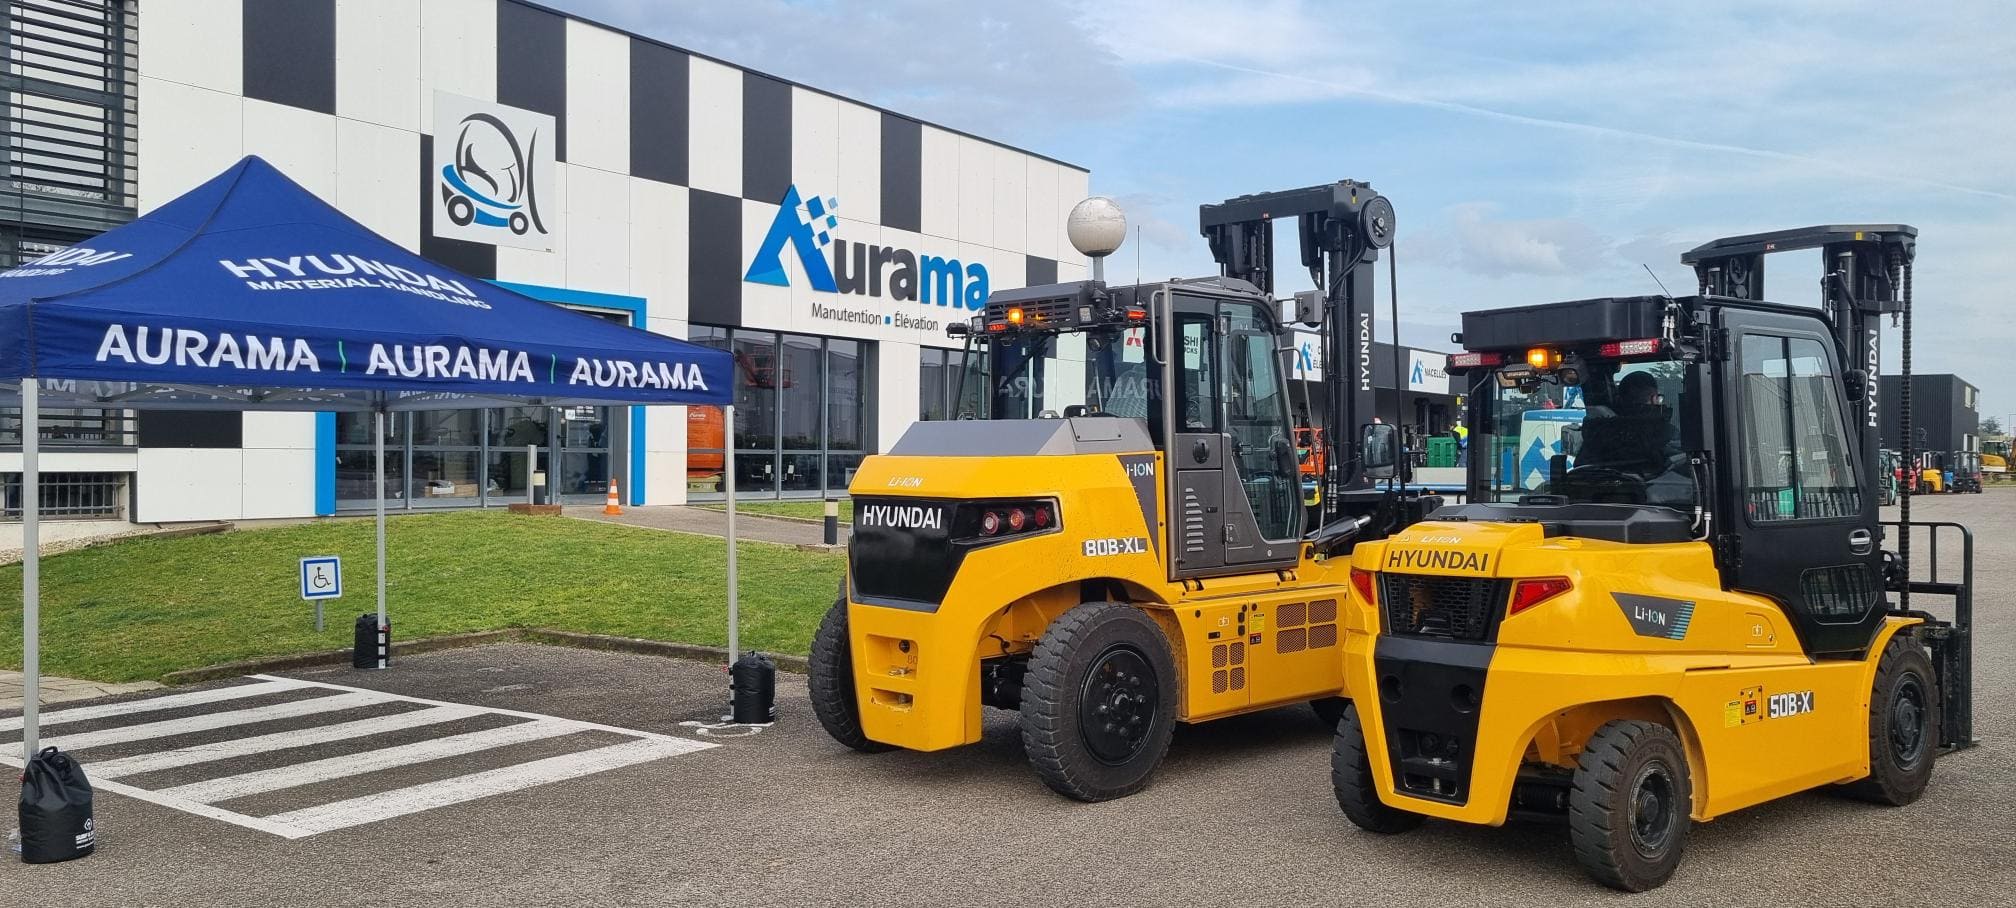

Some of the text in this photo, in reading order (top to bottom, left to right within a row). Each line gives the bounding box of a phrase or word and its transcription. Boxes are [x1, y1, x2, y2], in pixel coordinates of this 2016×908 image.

[219, 254, 478, 297] HYUNDAI
[247, 278, 493, 310] MATERIAL HANDLING
[811, 302, 939, 331] Manutention Élévation
[96, 324, 321, 372] AURAMA
[1184, 335, 1199, 347] SHI
[1360, 313, 1371, 391] HYUNDAI
[365, 344, 536, 383] AURAMA
[569, 358, 709, 391] AURAMA
[1868, 329, 1878, 427] HYUNDAI
[862, 504, 942, 530] HYUNDAI
[1085, 537, 1146, 557] 80B-XL
[1388, 550, 1489, 572] HYUNDAI
[1635, 605, 1666, 626] Li-ION
[1770, 690, 1811, 719] 50B-X
